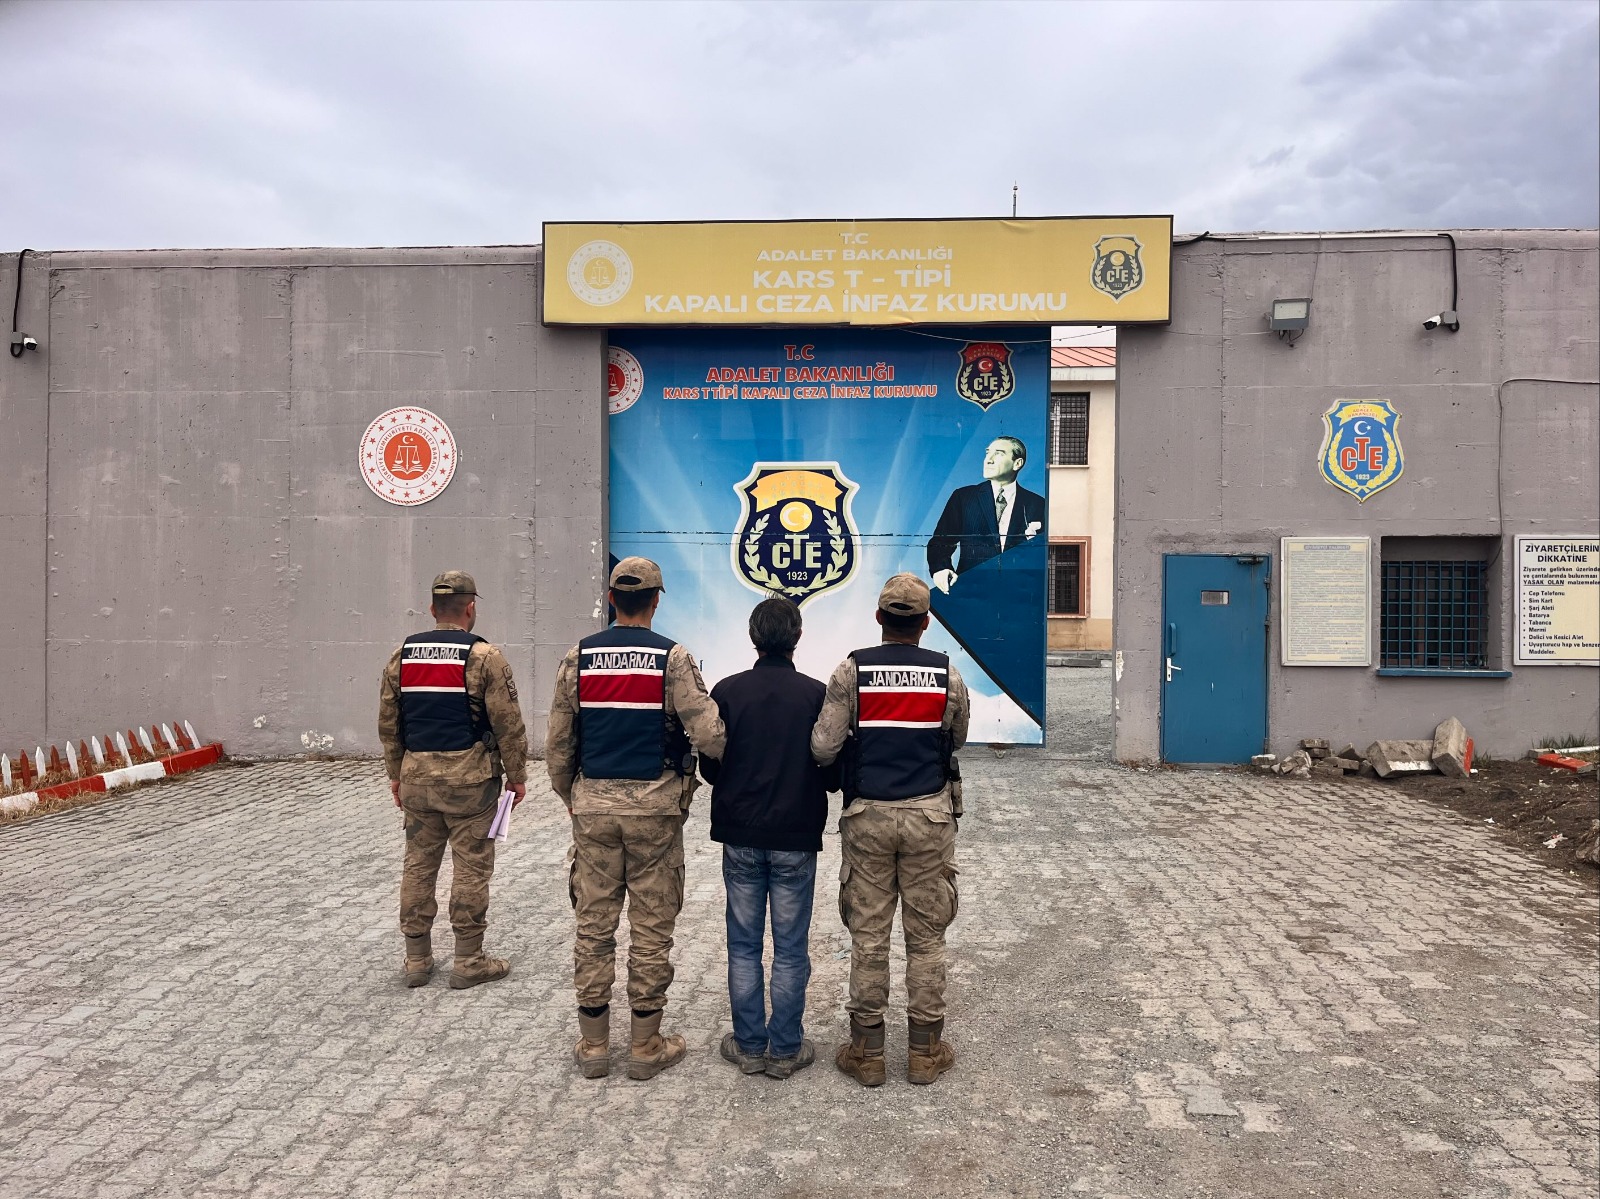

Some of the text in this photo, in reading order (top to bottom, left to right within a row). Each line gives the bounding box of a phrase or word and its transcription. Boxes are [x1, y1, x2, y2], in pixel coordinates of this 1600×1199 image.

[840, 232, 869, 245] T.C
[756, 246, 953, 262] ADALET BAKANLIĞI
[753, 270, 835, 289] KARS
[843, 270, 864, 288] T
[894, 264, 952, 288] TİPİ
[1106, 265, 1129, 283] CTE
[645, 289, 1067, 313] KAPALI CEZA İNFAZ KURUMU
[784, 344, 815, 361] T.C
[705, 361, 895, 383] ADALET BAKANLIĞI
[973, 372, 998, 391] CTE
[663, 386, 700, 400] KARS
[711, 383, 738, 400] TİPİ
[741, 386, 791, 400] KAPALI
[793, 386, 828, 400] CEZA
[830, 383, 871, 399] İNFAZ
[873, 384, 938, 398] KURUMU
[413, 427, 435, 445] ADALET
[1340, 437, 1383, 472] CTE
[771, 533, 822, 569] CTE
[1525, 543, 1599, 554] ZİYARETÇİLERİN
[1537, 553, 1588, 563] DİKKATİNE
[786, 571, 808, 581] 1923
[407, 646, 461, 660] JANDARMA
[1562, 641, 1573, 649] hap
[588, 652, 657, 670] JANDARMA
[868, 671, 938, 687] JANDARMA
